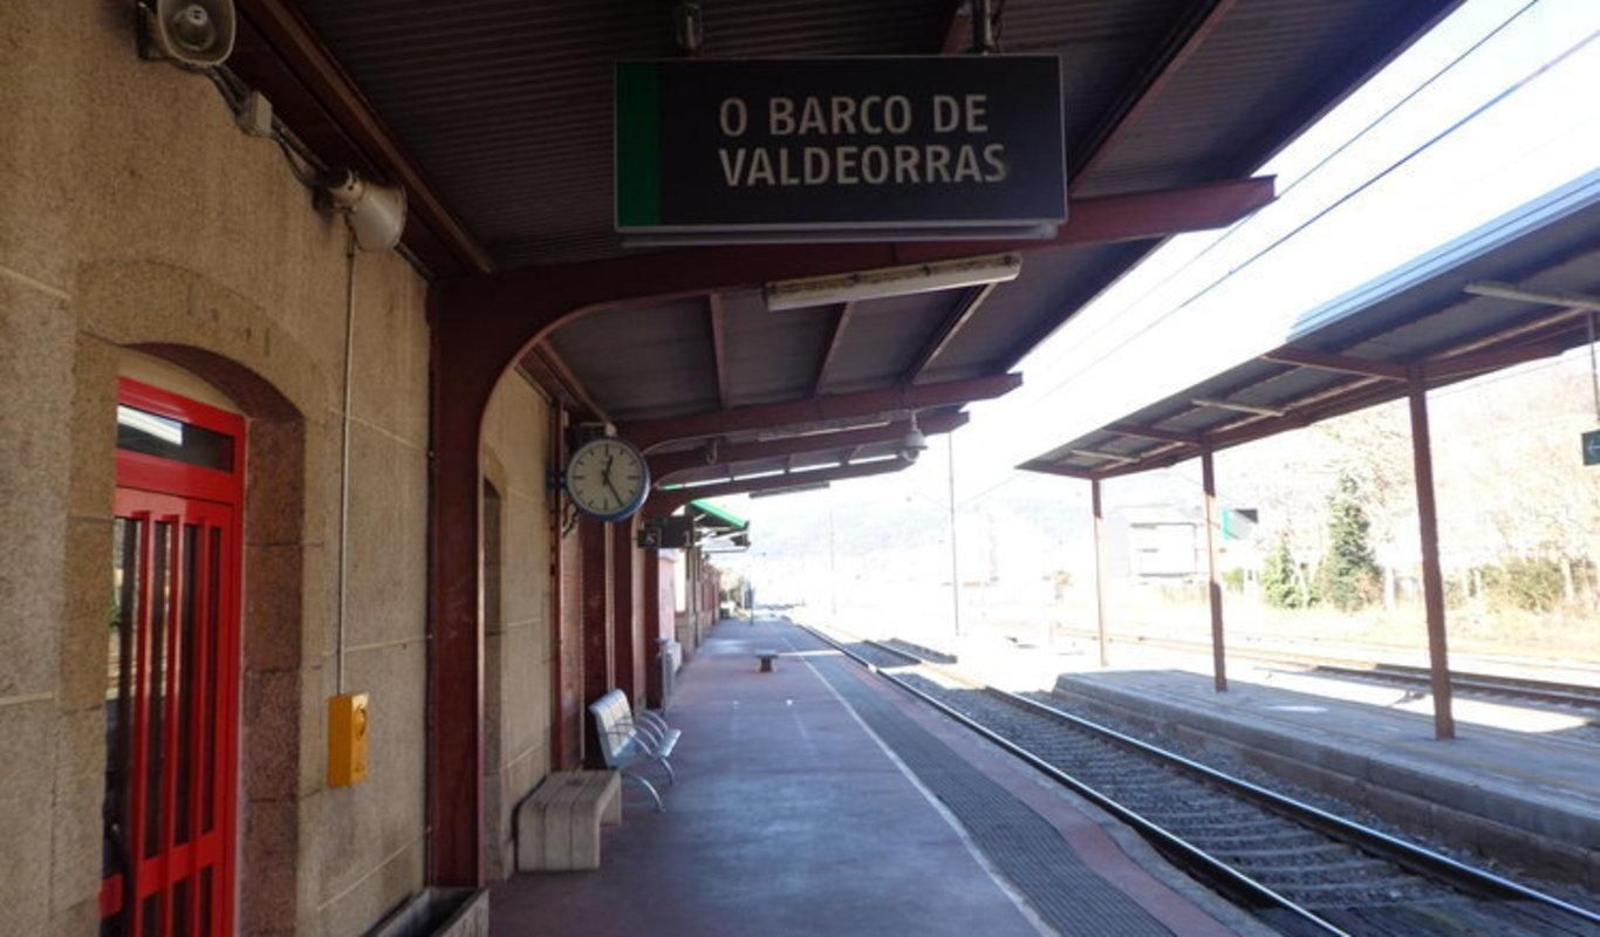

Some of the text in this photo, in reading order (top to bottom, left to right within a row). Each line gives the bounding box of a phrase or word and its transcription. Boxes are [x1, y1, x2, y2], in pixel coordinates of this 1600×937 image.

[719, 95, 988, 136] O BARCO DE
[718, 144, 1007, 186] VALDEORRAS
